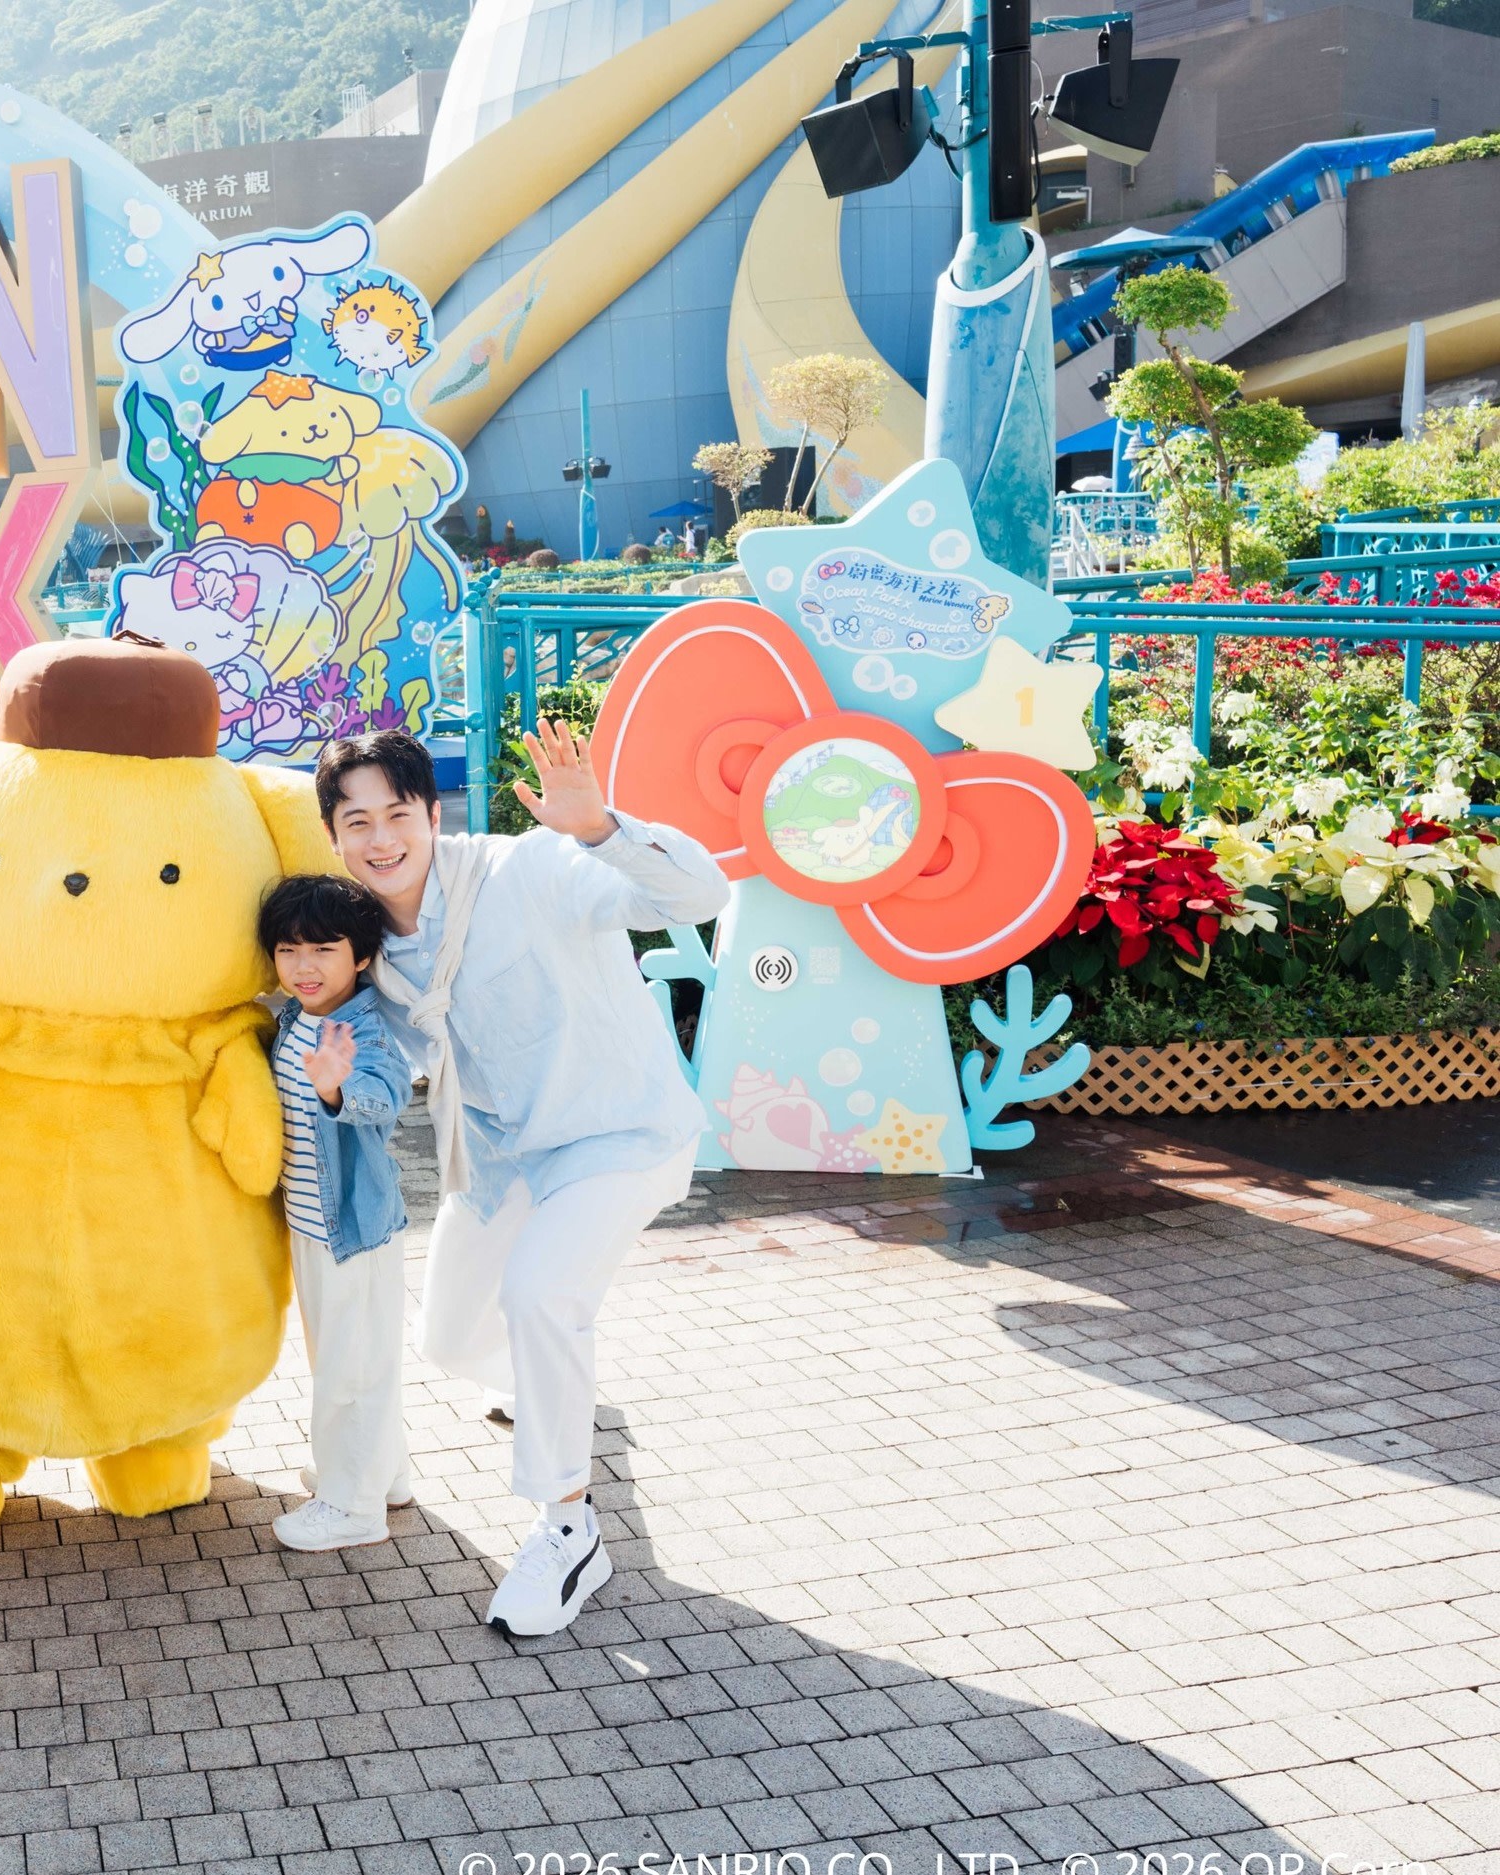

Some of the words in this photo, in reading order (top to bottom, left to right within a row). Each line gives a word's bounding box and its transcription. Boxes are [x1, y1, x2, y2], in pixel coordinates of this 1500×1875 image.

[823, 585, 868, 600] Ocean
[870, 585, 905, 607] Park
[847, 562, 962, 599] 蔚藍海洋之旅
[852, 598, 897, 621] Sanrio
[899, 612, 971, 634] characters
[918, 594, 942, 607] Marine
[943, 597, 974, 612] Wonders
[1015, 687, 1035, 727] 1
